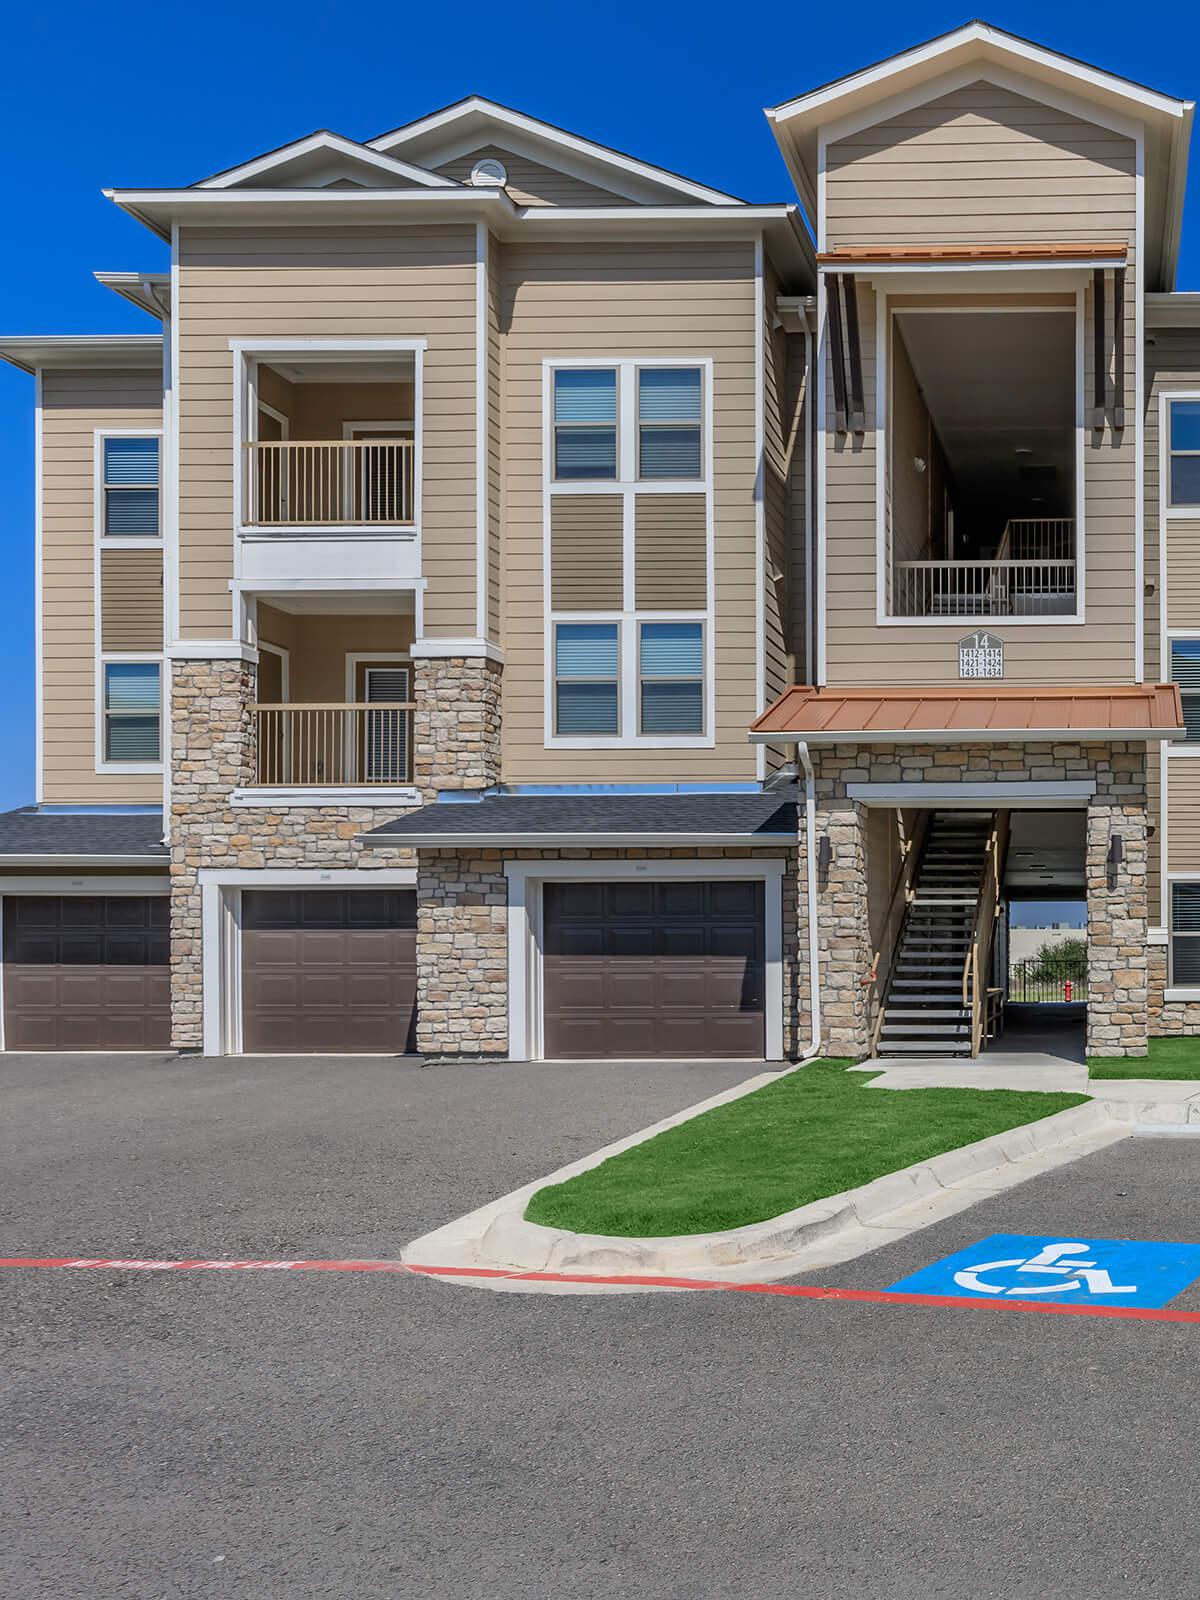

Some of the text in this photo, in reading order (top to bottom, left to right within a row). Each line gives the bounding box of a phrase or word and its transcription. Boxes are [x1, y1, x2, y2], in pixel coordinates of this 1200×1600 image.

[973, 635, 989, 649] 14
[961, 650, 1001, 658] 1412-1414
[961, 659, 1001, 667] 1421-1424
[961, 668, 1001, 677] 1431-1434
